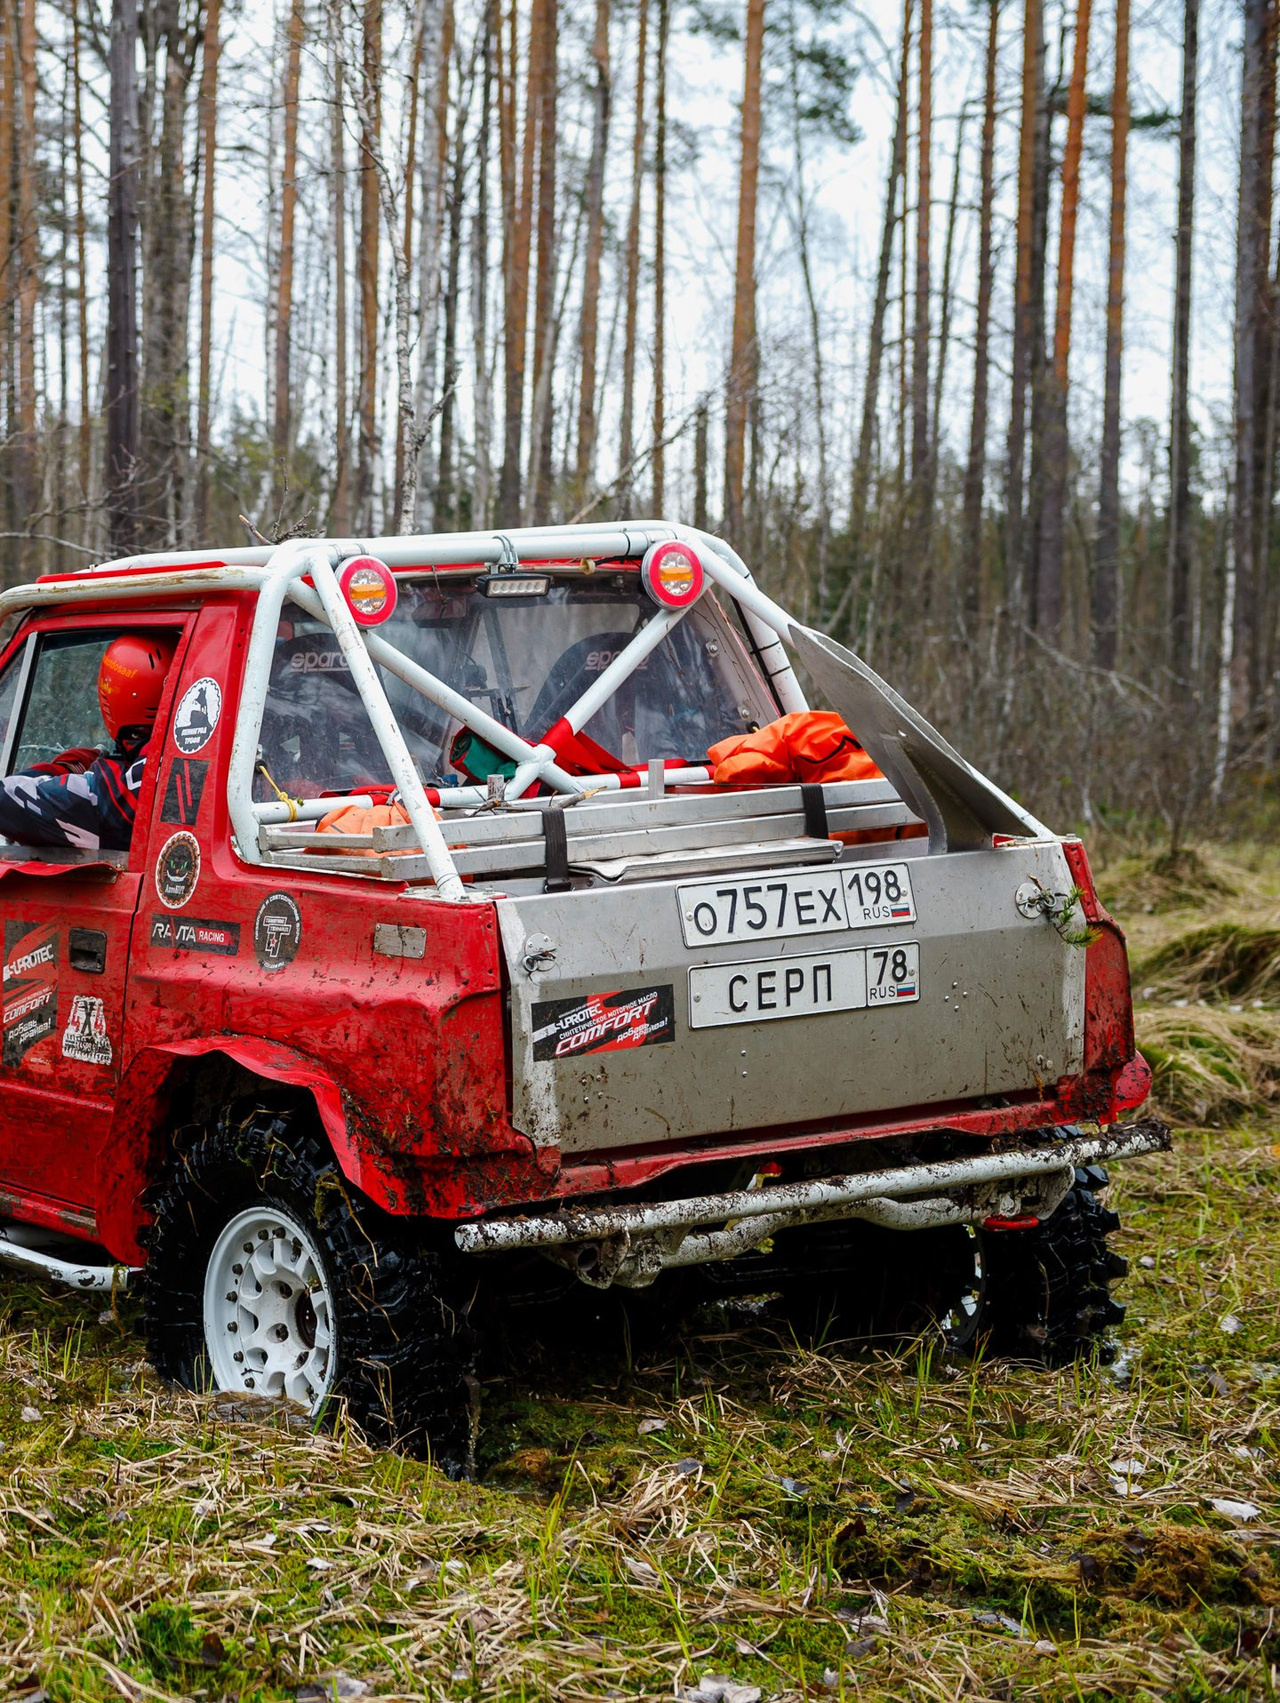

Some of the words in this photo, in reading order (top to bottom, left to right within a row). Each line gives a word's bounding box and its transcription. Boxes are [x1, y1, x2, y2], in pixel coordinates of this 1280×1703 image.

[291, 651, 348, 673] sparc
[847, 869, 902, 907] 198
[862, 906, 891, 920] RUS
[198, 930, 225, 943] RACING
[873, 949, 908, 986] 78
[728, 963, 833, 1013] СЕРП
[870, 985, 896, 1000] RUS
[3, 991, 53, 1024] COMFORT
[559, 1014, 608, 1040] СИНТЕТИЧЕСКОЕ
[607, 1001, 638, 1017] МОТОРНОЕ
[637, 991, 658, 1005] МАСЛО
[555, 998, 658, 1056] COMFORT
